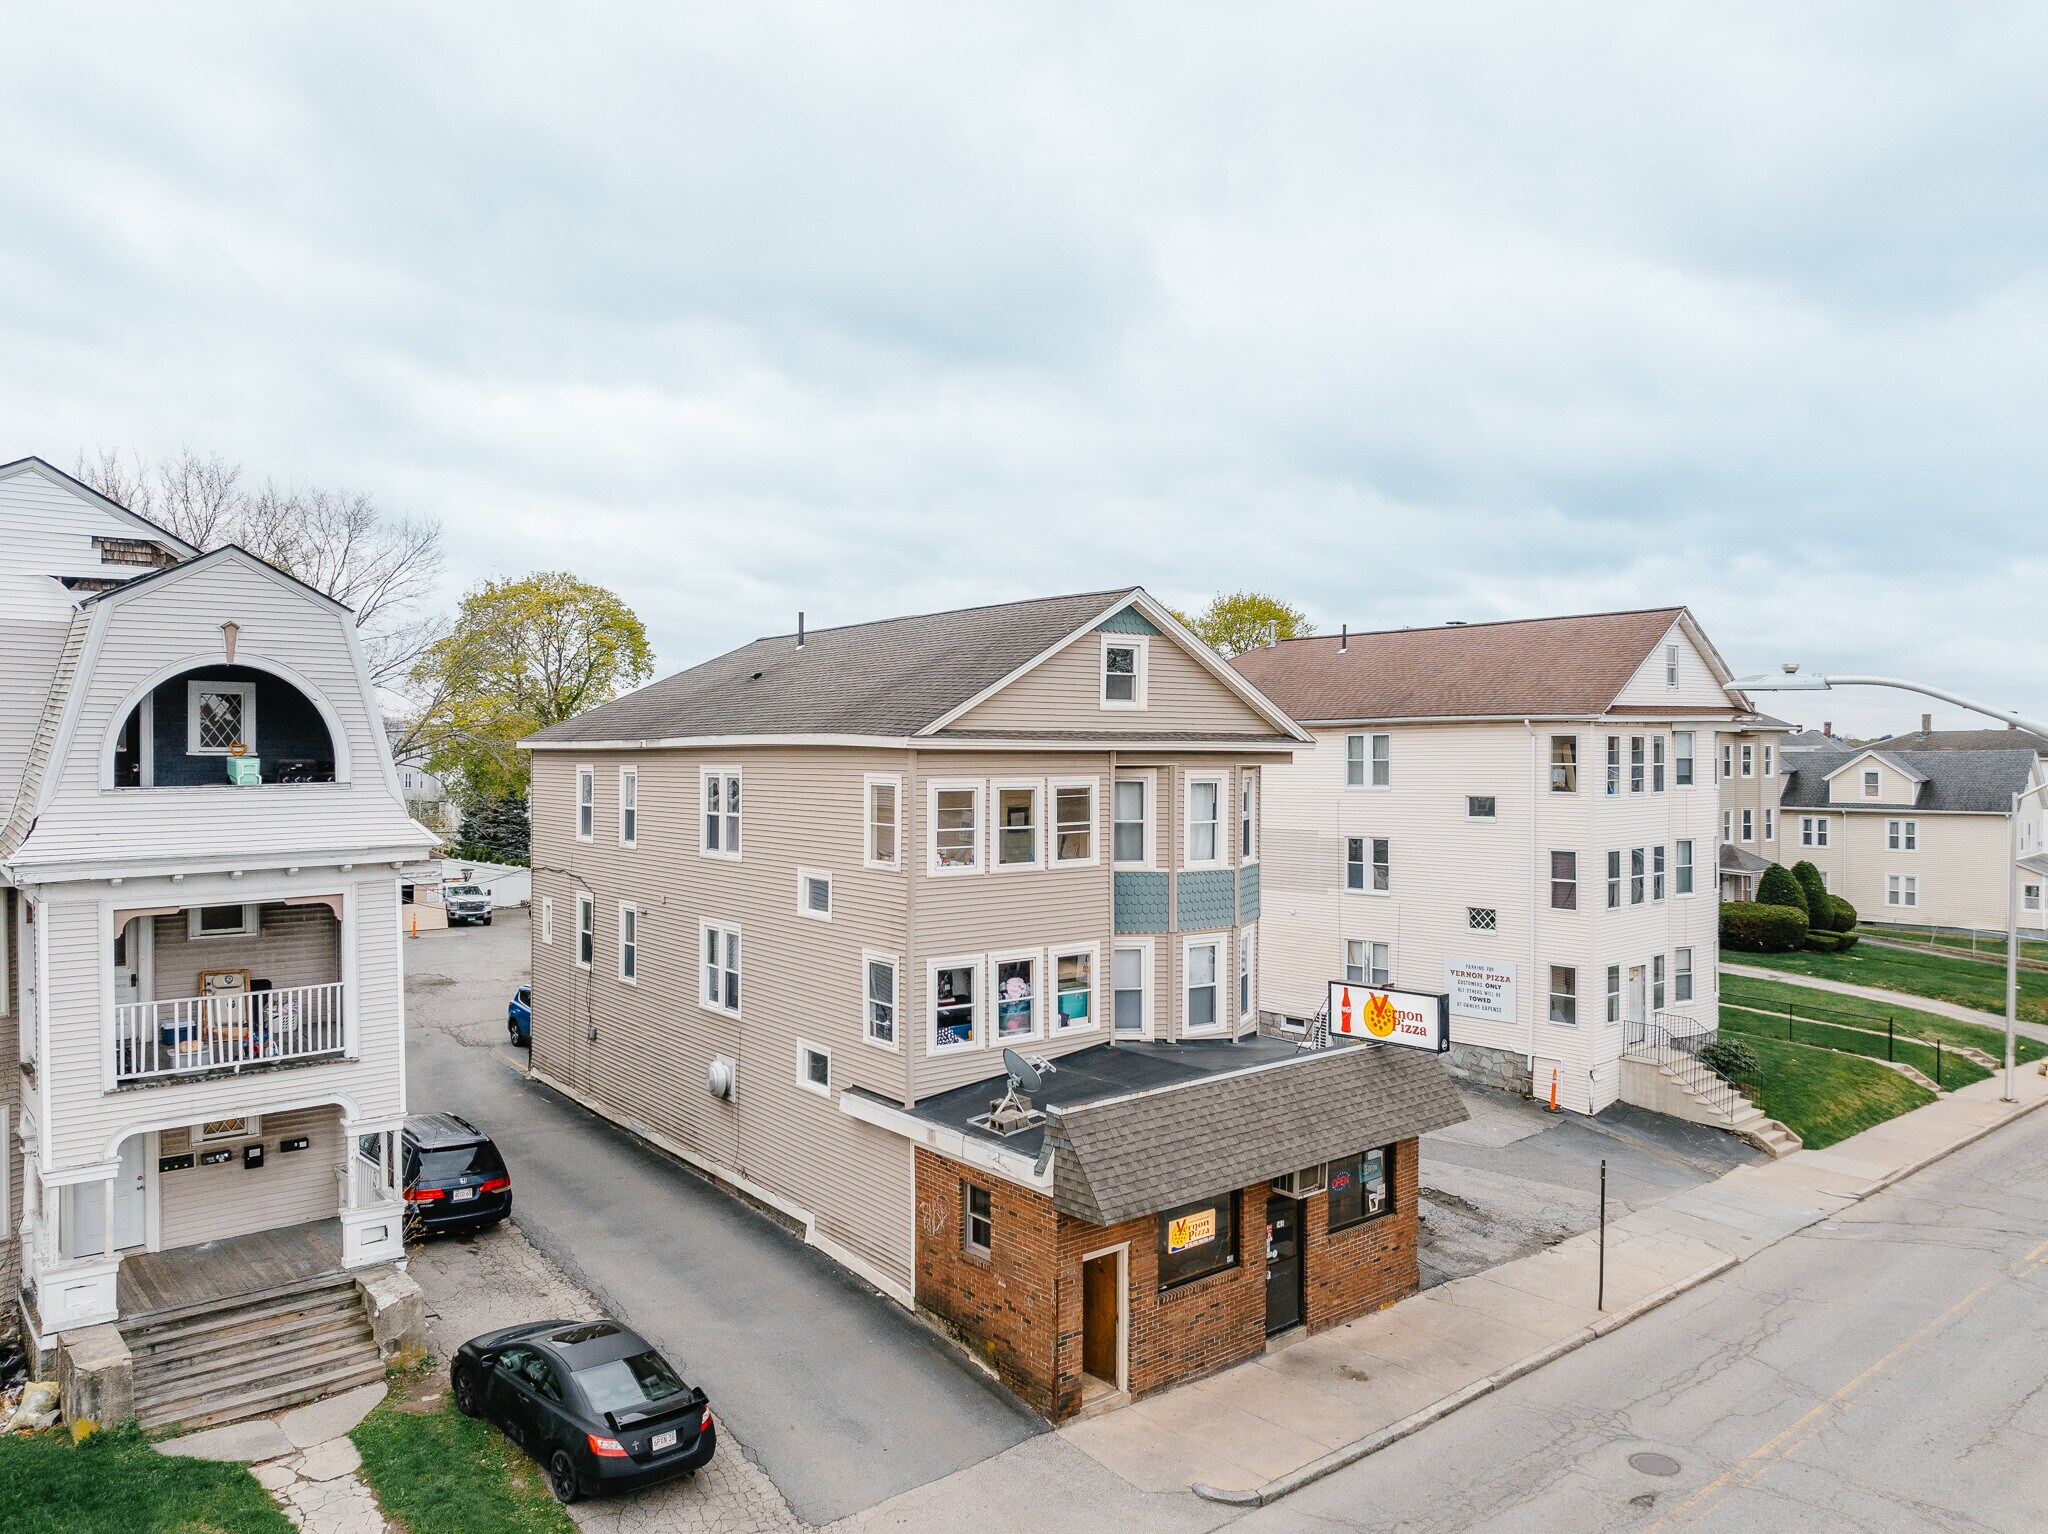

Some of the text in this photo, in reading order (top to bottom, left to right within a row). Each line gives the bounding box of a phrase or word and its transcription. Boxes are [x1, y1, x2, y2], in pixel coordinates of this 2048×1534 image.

[1450, 969, 1511, 983] VERNON PIZZA
[1485, 982, 1502, 990] ONLY
[1469, 995, 1492, 1004] TOWED
[1369, 992, 1423, 1022] Vernon
[1392, 1016, 1427, 1036] Pizza
[1331, 1175, 1350, 1188] OPEN
[1176, 1219, 1210, 1236] Vernon
[1188, 1227, 1210, 1241] Pizza
